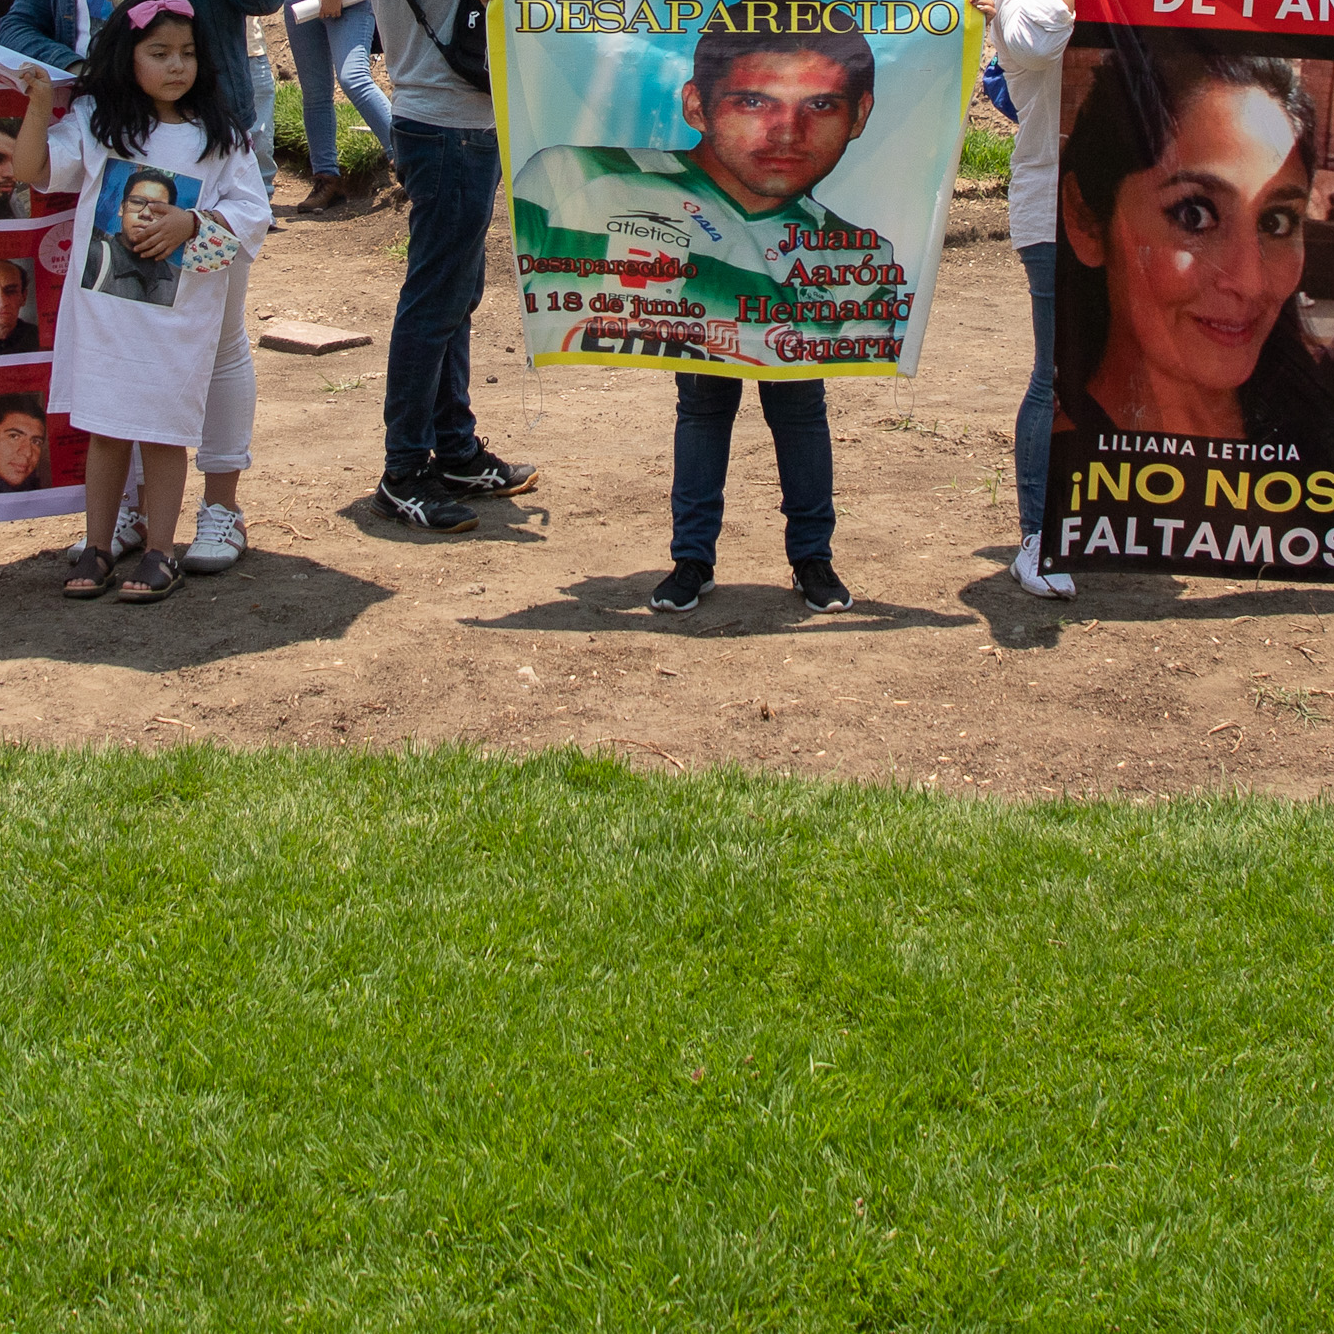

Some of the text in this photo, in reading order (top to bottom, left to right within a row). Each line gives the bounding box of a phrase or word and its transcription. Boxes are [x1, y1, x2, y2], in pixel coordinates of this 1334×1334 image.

[606, 220, 691, 249] atletica
[778, 223, 881, 253] Juan
[516, 254, 699, 279] Desaparecido
[781, 254, 907, 287] Aarón
[547, 291, 584, 312] 18
[589, 293, 625, 313] de
[629, 295, 706, 319] junio
[735, 293, 915, 324] Hernand
[585, 316, 706, 345] del 2009
[1099, 434, 1301, 461] LILIANA LETICIA
[1070, 461, 1185, 512] ¡NO
